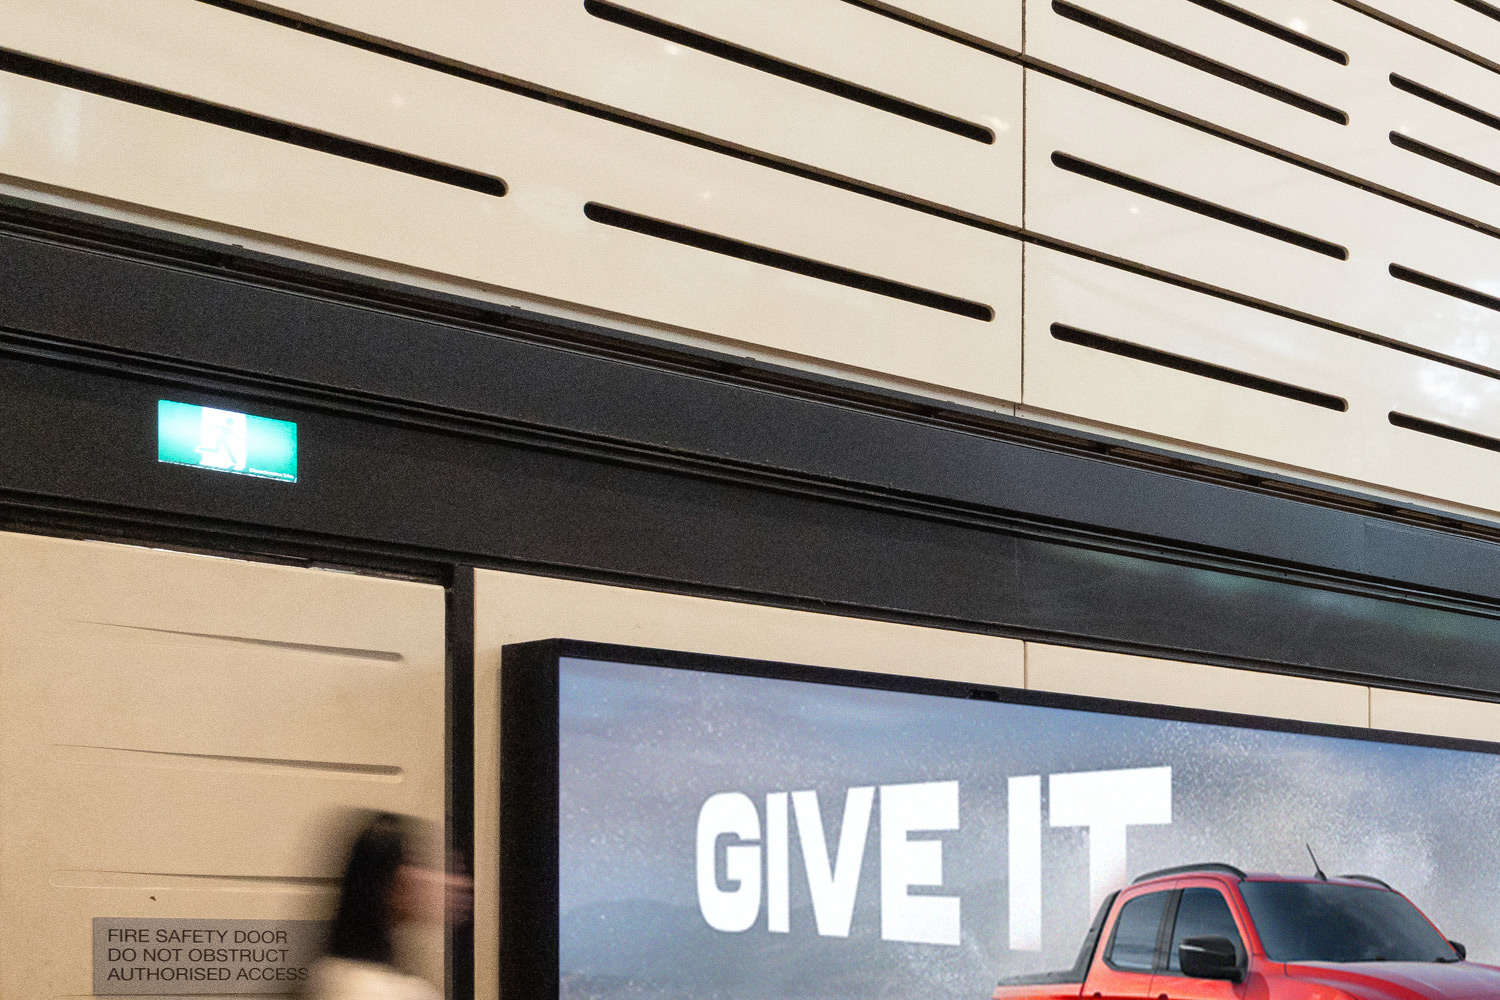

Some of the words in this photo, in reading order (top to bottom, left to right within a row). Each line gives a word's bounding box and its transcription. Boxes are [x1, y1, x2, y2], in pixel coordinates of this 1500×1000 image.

[696, 780, 961, 945] GIVE
[1008, 766, 1173, 951] IT
[107, 928, 150, 943] FIRE
[155, 929, 229, 943] SAFETY
[233, 930, 288, 944] DOOR
[107, 948, 137, 962] DO
[143, 948, 183, 962] NOT
[188, 948, 289, 963] OBSTRUCT
[106, 967, 231, 981] AUTHORISED
[236, 967, 309, 981] ACCESS
